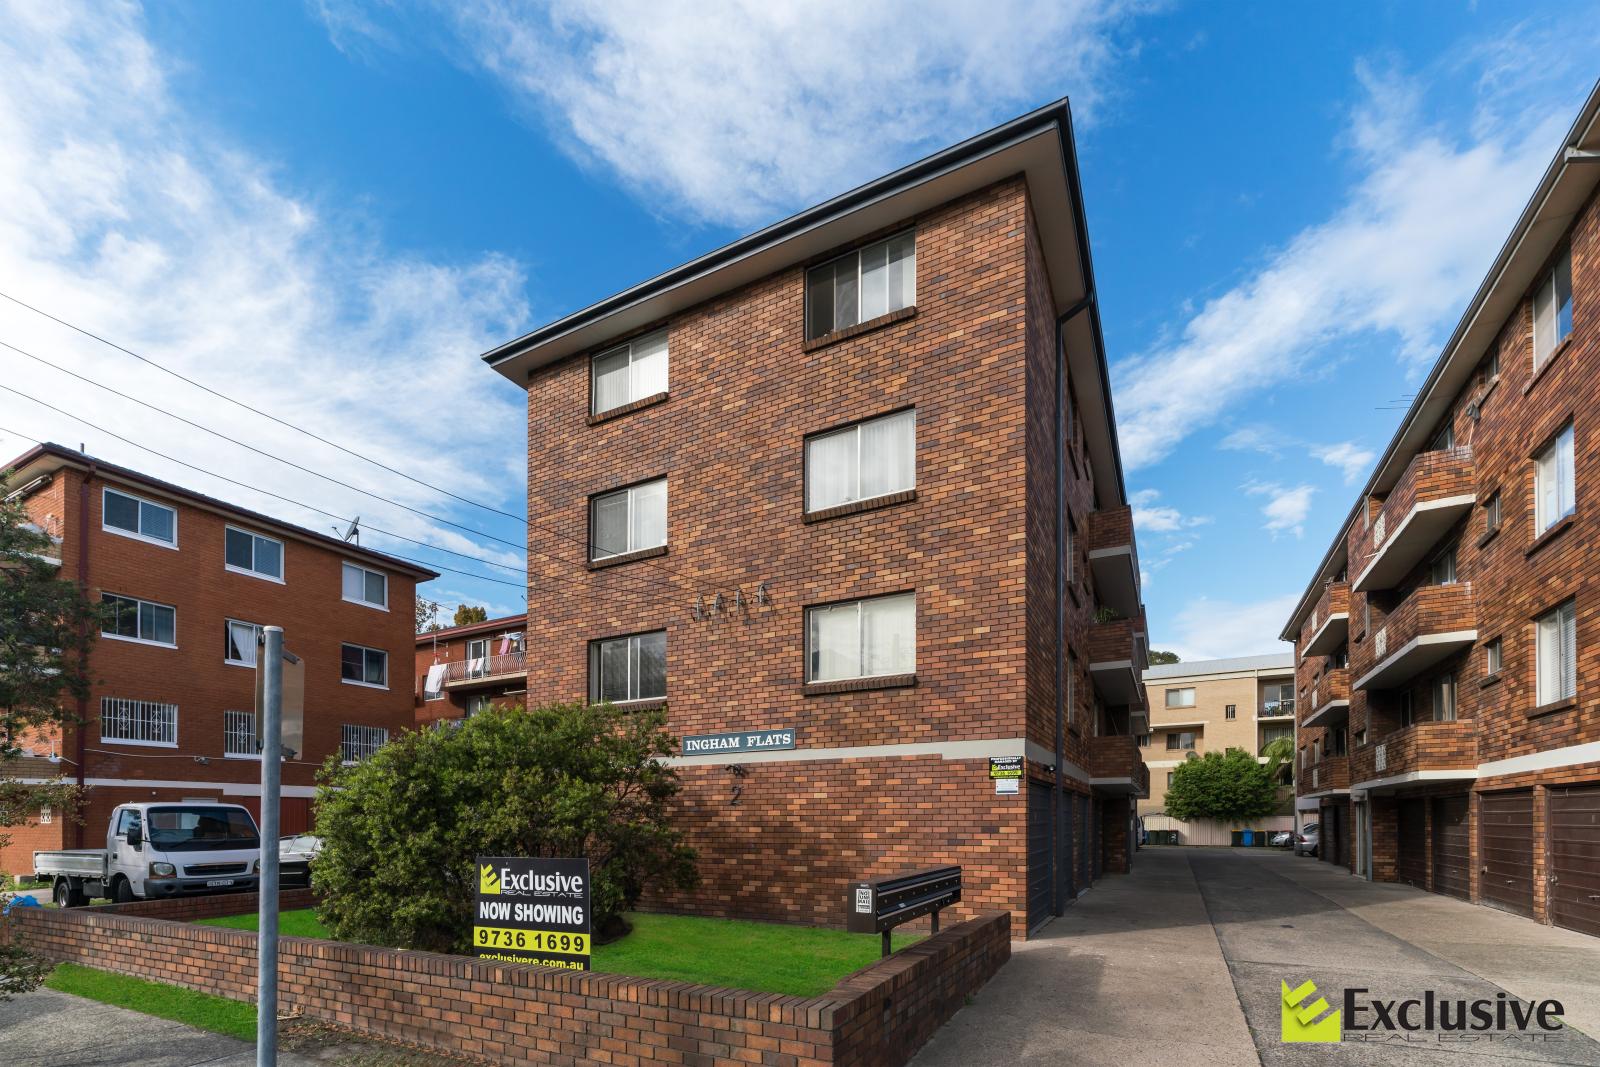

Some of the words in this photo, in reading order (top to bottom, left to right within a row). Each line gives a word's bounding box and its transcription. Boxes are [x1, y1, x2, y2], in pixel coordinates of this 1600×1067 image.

[686, 737, 740, 751] INGHAM
[746, 733, 791, 748] FLATS
[730, 785, 743, 806] 2
[500, 868, 583, 893] Exclusive
[534, 891, 583, 899] ESTATE
[480, 901, 511, 920] NOW
[514, 903, 584, 925] SHOWING
[479, 930, 526, 947] 9736
[534, 933, 584, 952] 1699
